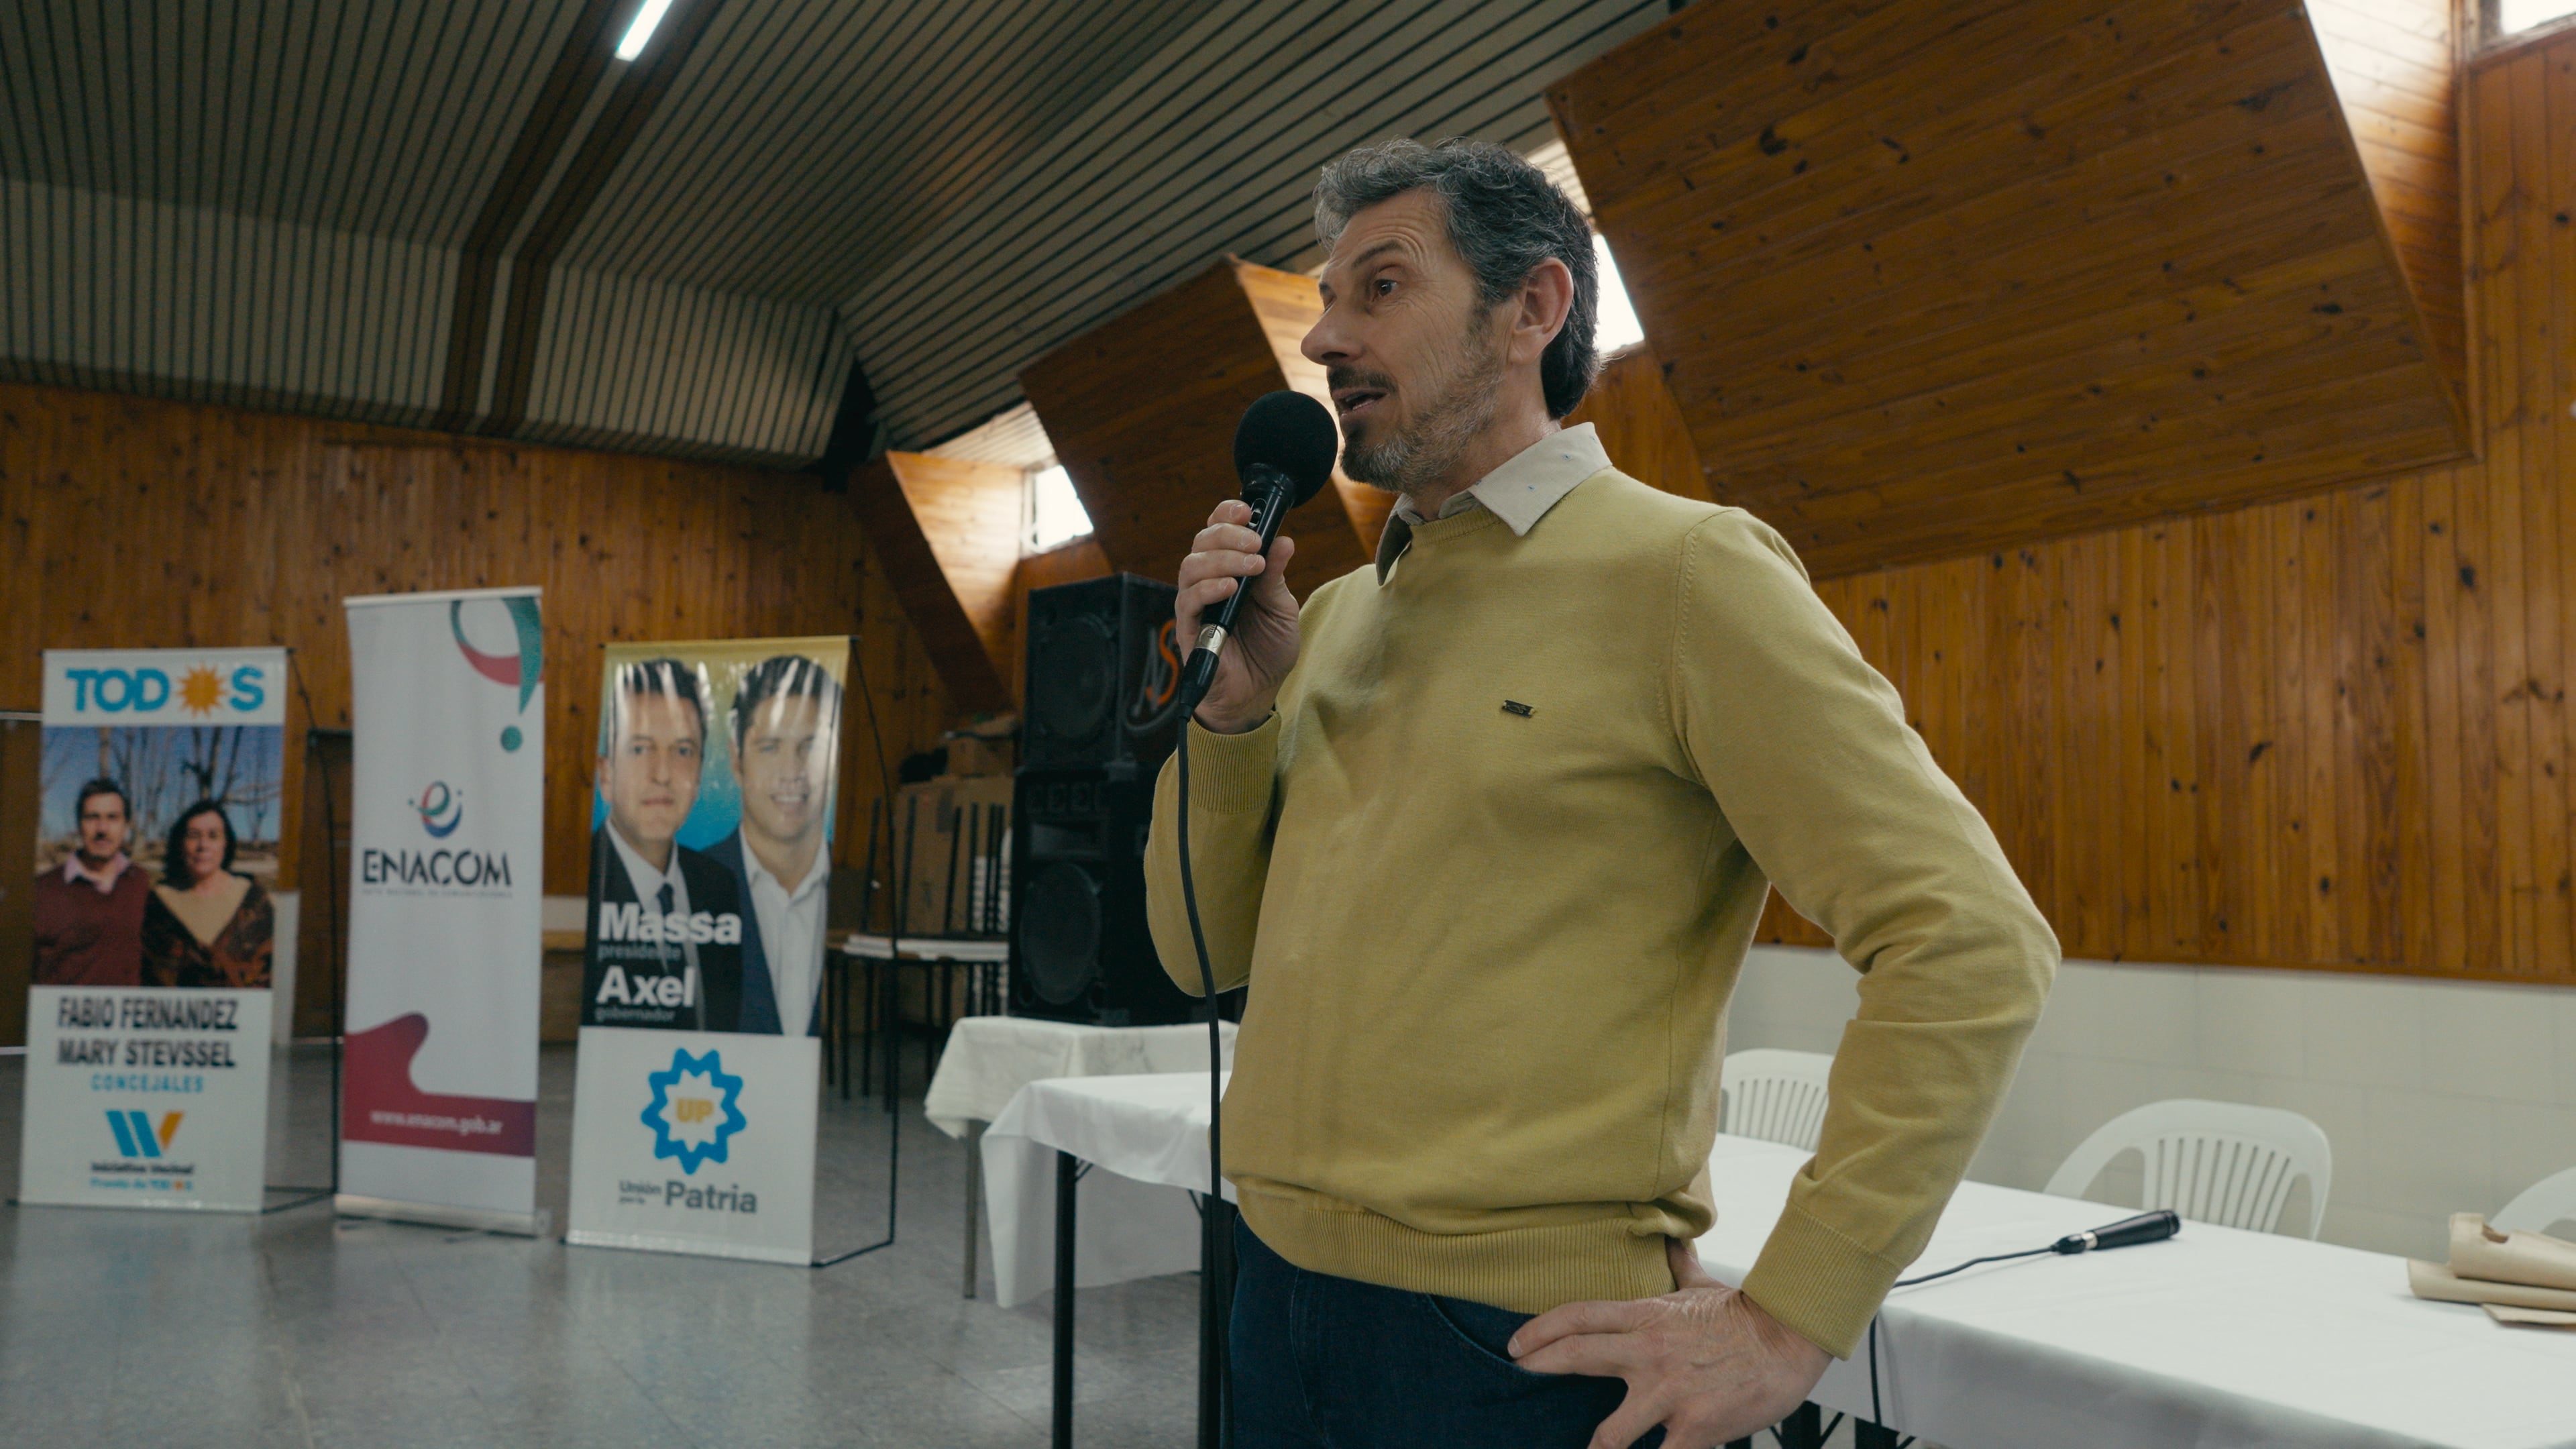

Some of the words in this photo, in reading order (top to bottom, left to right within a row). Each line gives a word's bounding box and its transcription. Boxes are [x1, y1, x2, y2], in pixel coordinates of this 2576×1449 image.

[363, 849, 512, 886] ENACOM
[598, 902, 742, 945] Massa
[596, 965, 695, 1007] Axel
[58, 997, 115, 1028] FABIO
[121, 998, 238, 1030] FERNANDEZ
[58, 1039, 119, 1065] MARY
[91, 1074, 204, 1093] CONCEJALES
[676, 1099, 714, 1123] UP
[665, 1181, 757, 1213] Patria
